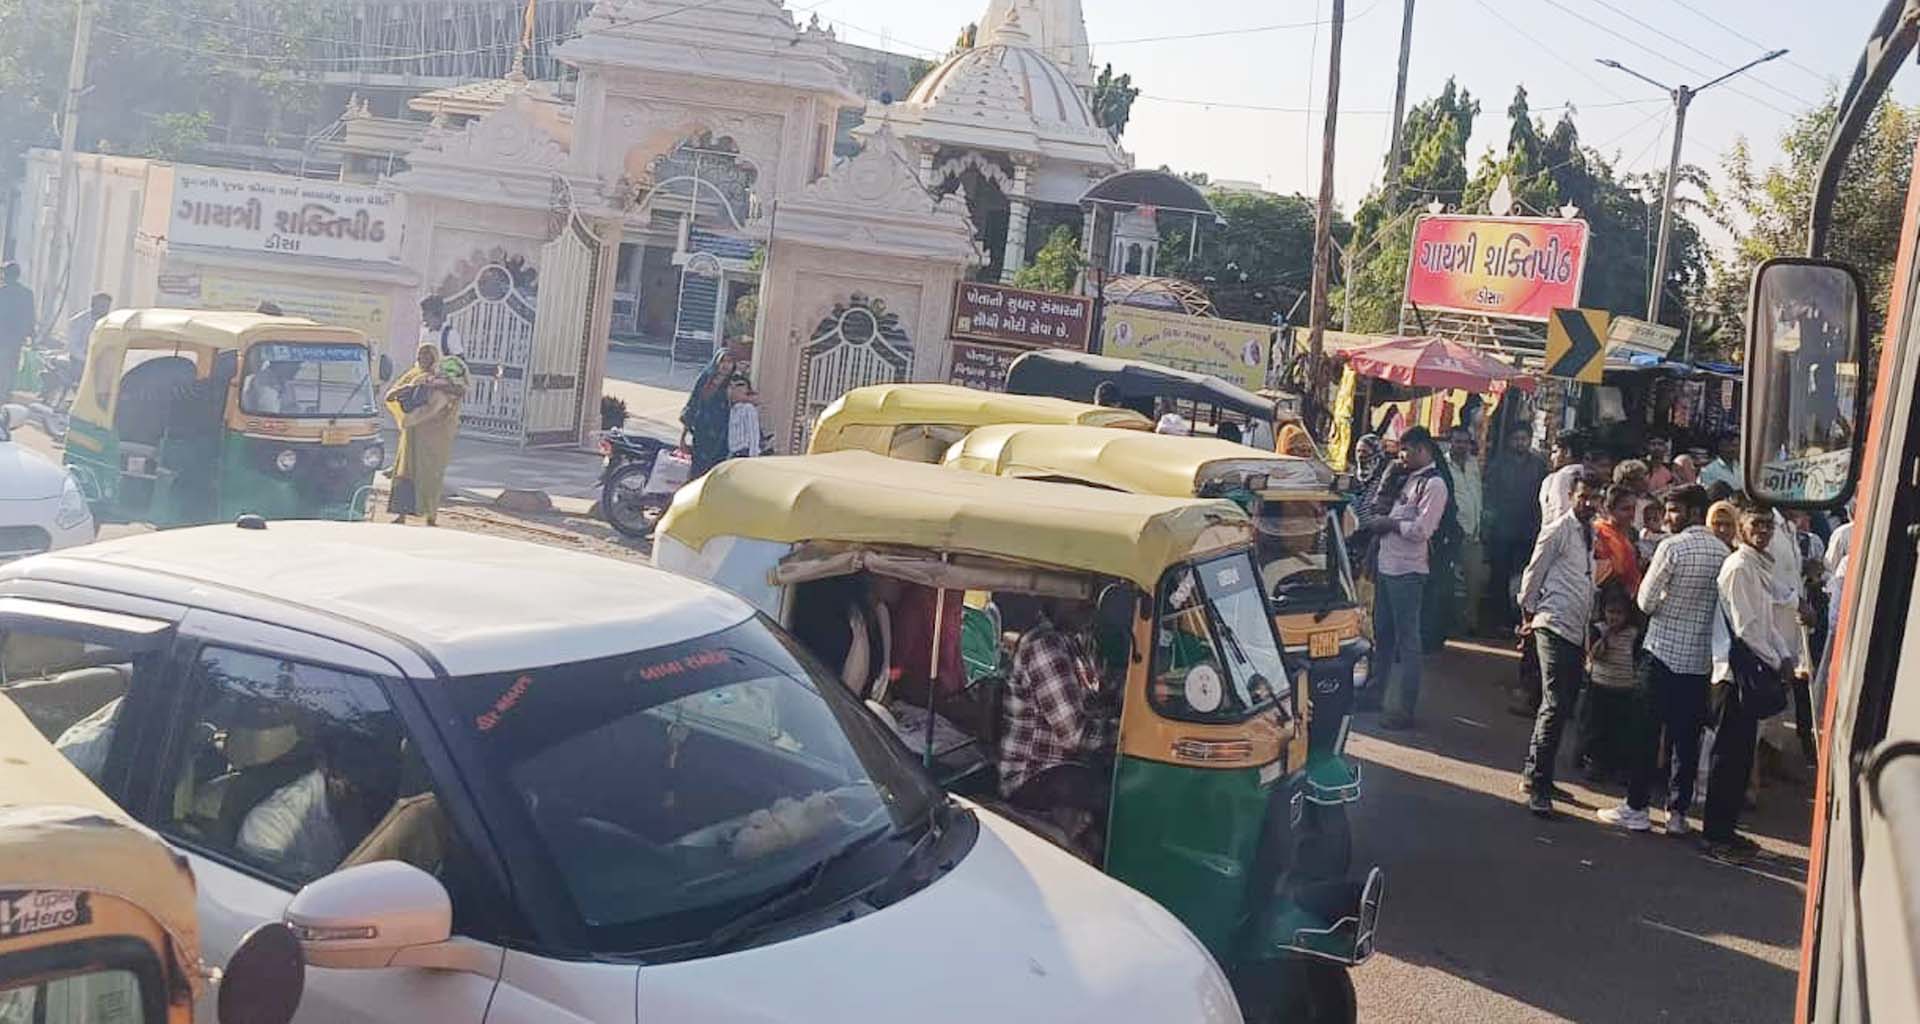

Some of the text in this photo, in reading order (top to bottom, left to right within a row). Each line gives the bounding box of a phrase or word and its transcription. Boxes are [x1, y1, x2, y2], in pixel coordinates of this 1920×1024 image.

[178, 197, 262, 231] ગાયત્રી
[273, 203, 385, 243] શક્તિપીઠ
[264, 232, 300, 251] ડીસા
[1419, 231, 1571, 283] ગાયત્રી શક્તિપીઠ
[1477, 286, 1500, 305] ડીસા
[1003, 315, 1026, 332] મોટી
[1030, 320, 1052, 336] સેવા
[20, 908, 75, 930] Hero
